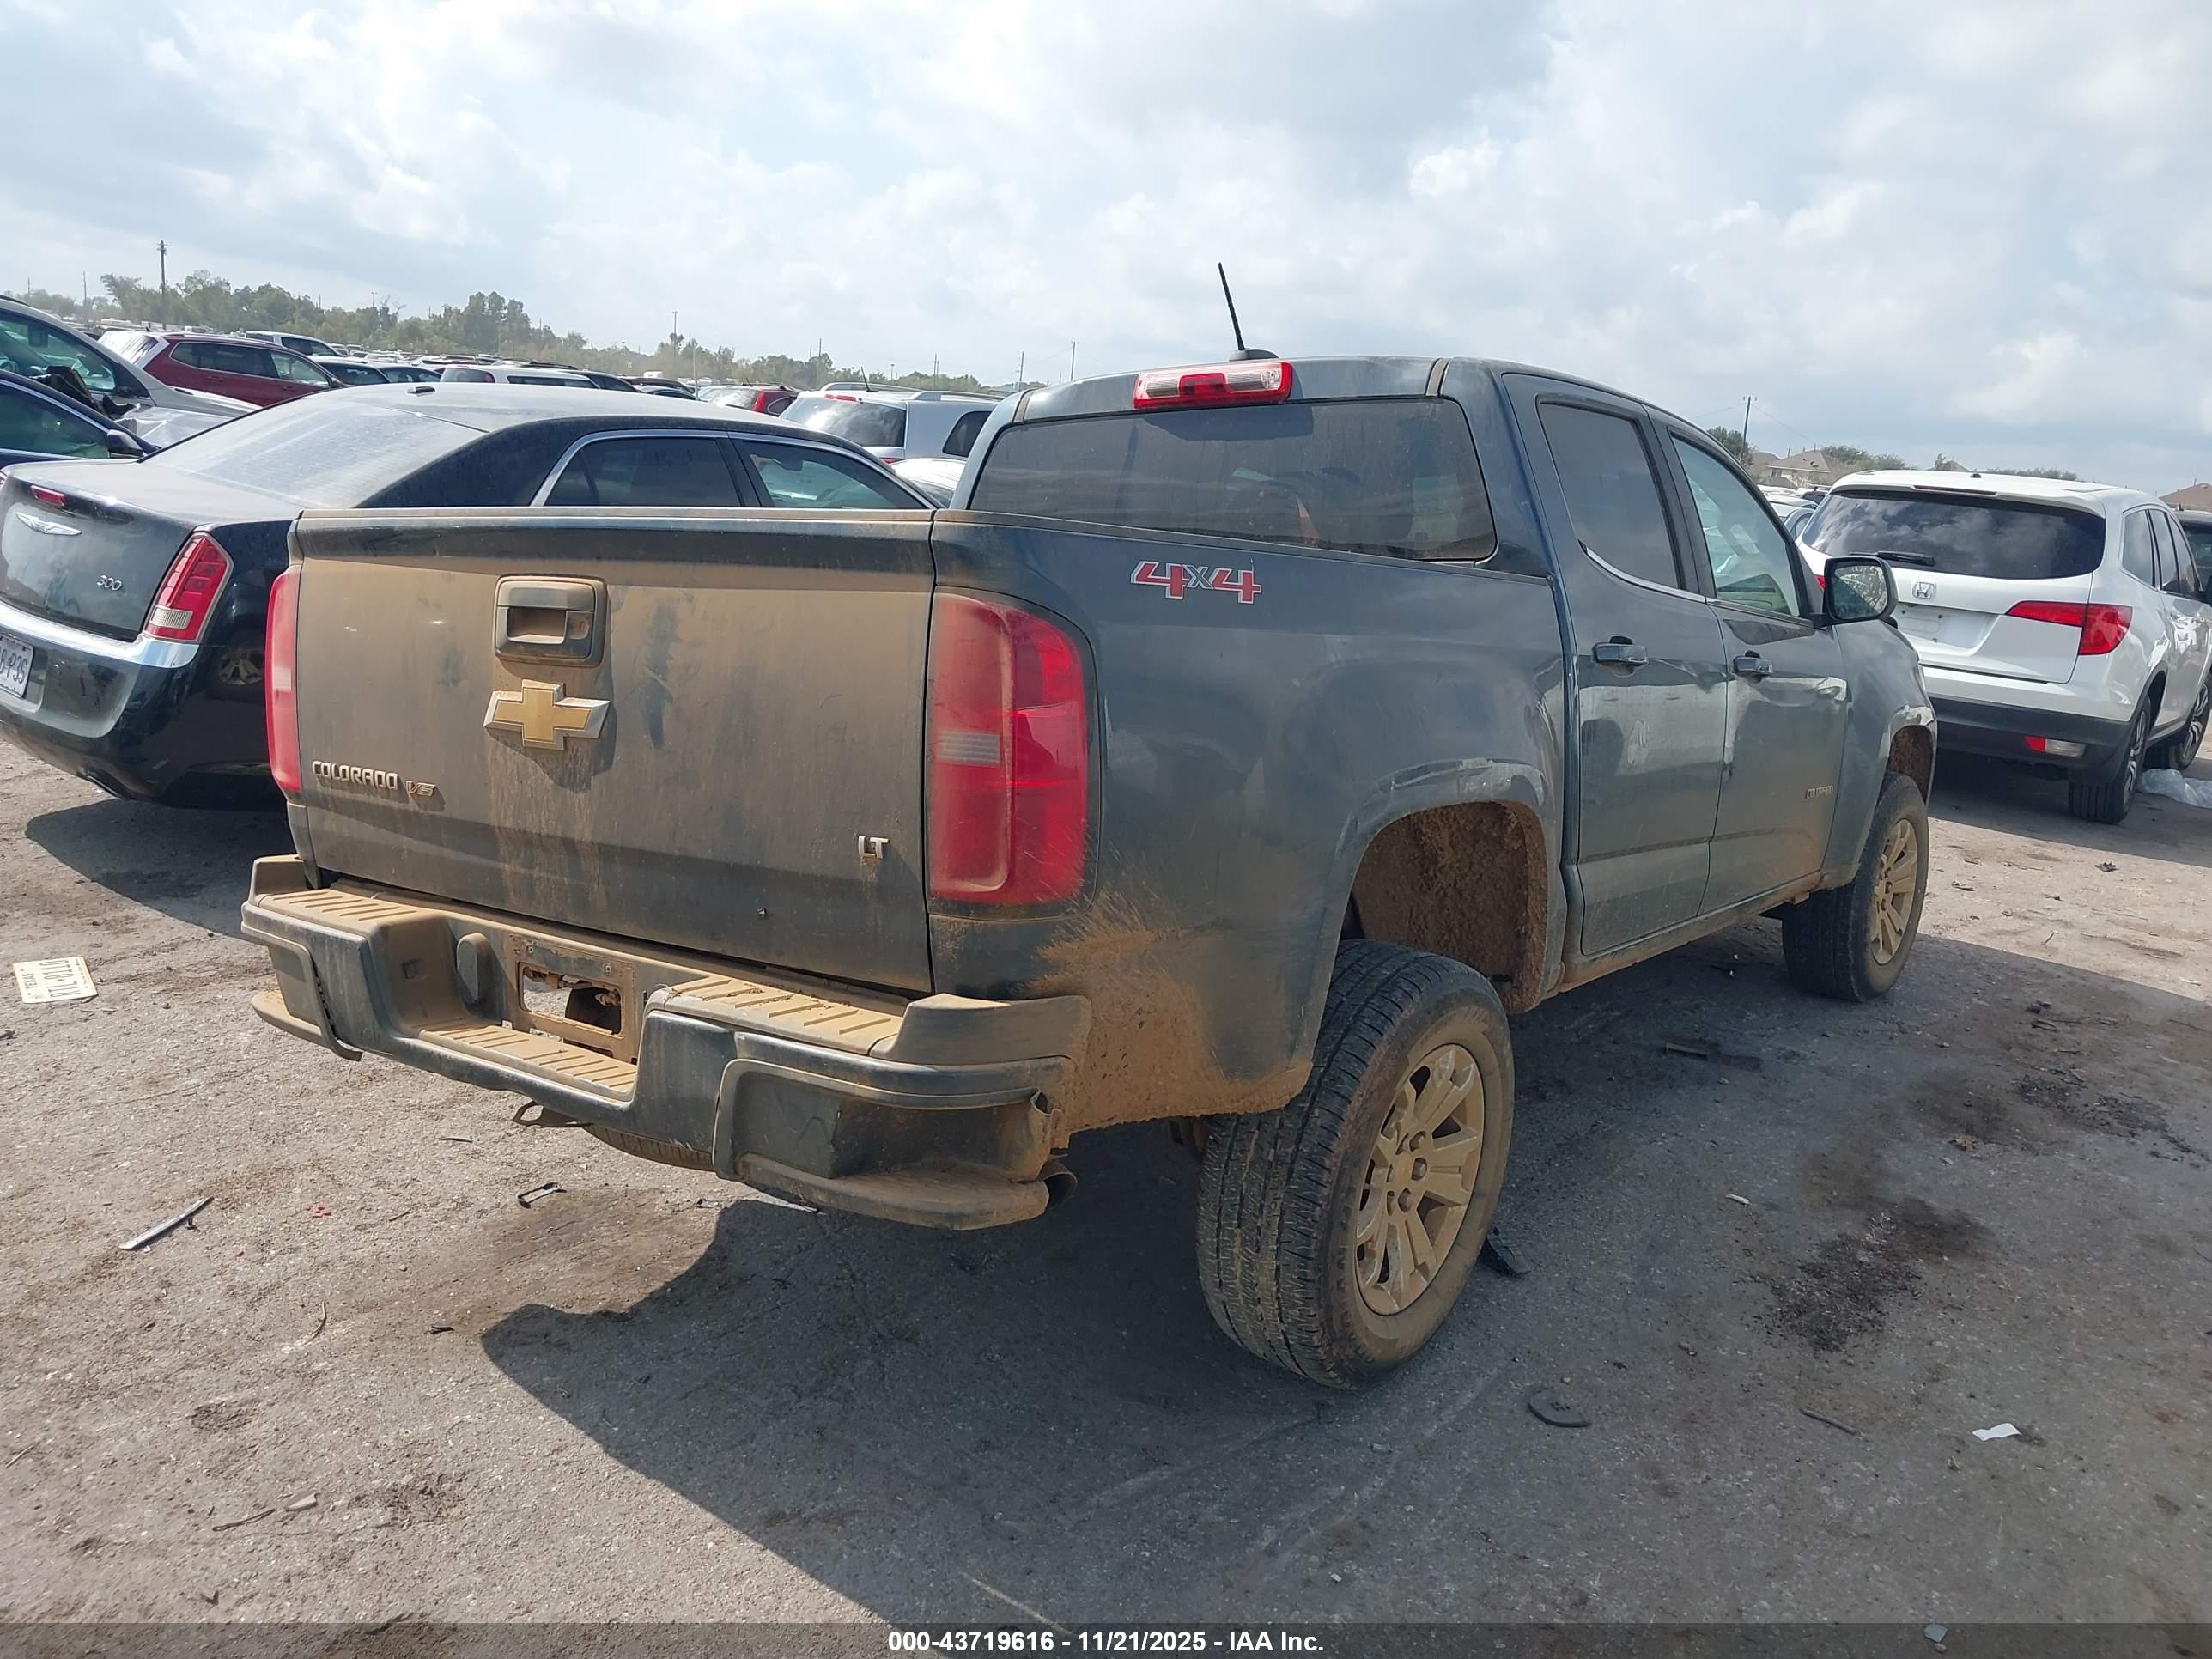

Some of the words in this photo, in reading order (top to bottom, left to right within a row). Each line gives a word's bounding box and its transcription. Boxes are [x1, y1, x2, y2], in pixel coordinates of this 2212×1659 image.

[96, 574, 122, 591] 300
[312, 760, 399, 791] COLORADO
[405, 780, 436, 797] V6
[858, 836, 890, 859] LT
